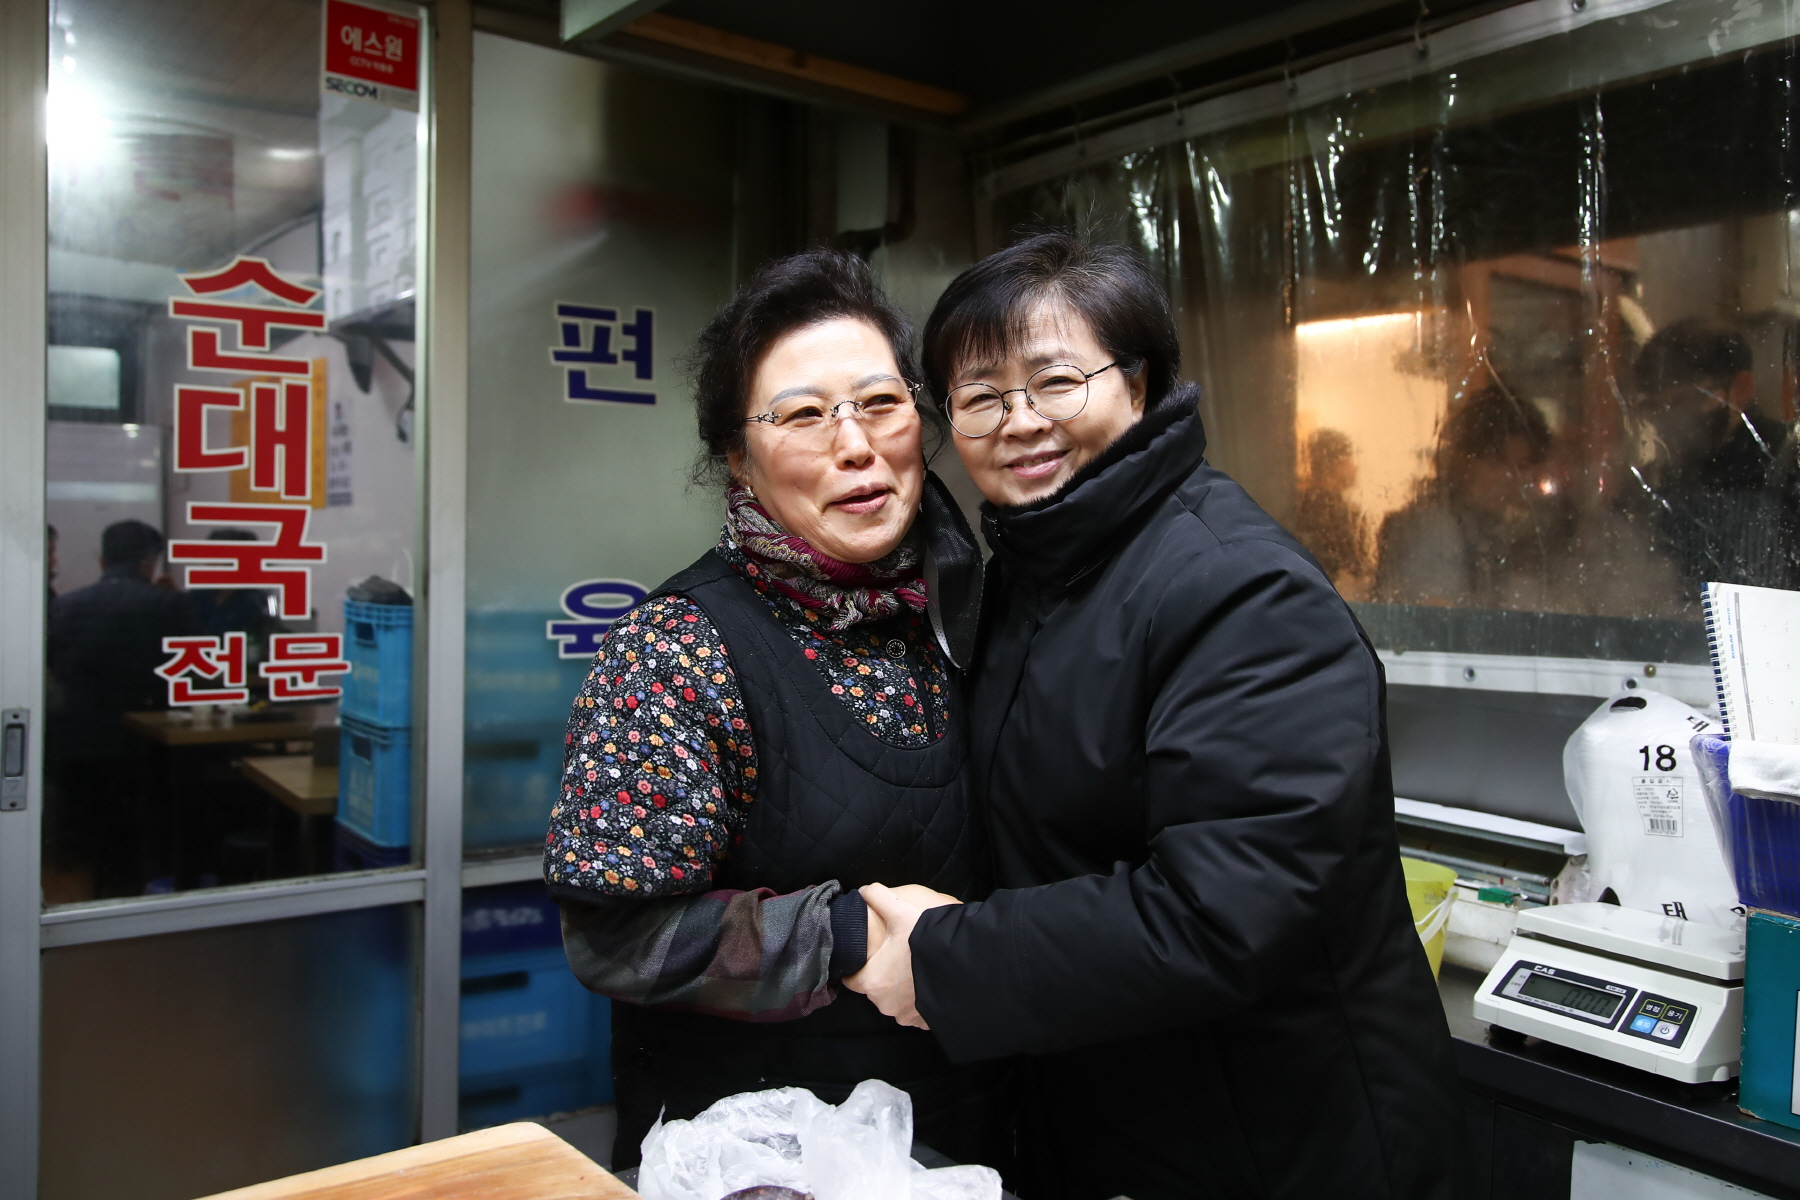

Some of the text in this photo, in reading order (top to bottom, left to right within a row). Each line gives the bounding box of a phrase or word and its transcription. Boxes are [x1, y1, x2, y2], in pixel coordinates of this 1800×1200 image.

[340, 25, 403, 62] 에스원
[326, 76, 378, 99] SECOM
[169, 255, 327, 621] 순대국
[154, 632, 352, 706] 전문
[1639, 744, 1677, 772] 18
[1661, 901, 1688, 920] 태
[1534, 965, 1556, 975] CAS
[1645, 1004, 1661, 1013] 영점
[1667, 1009, 1683, 1020] 용기
